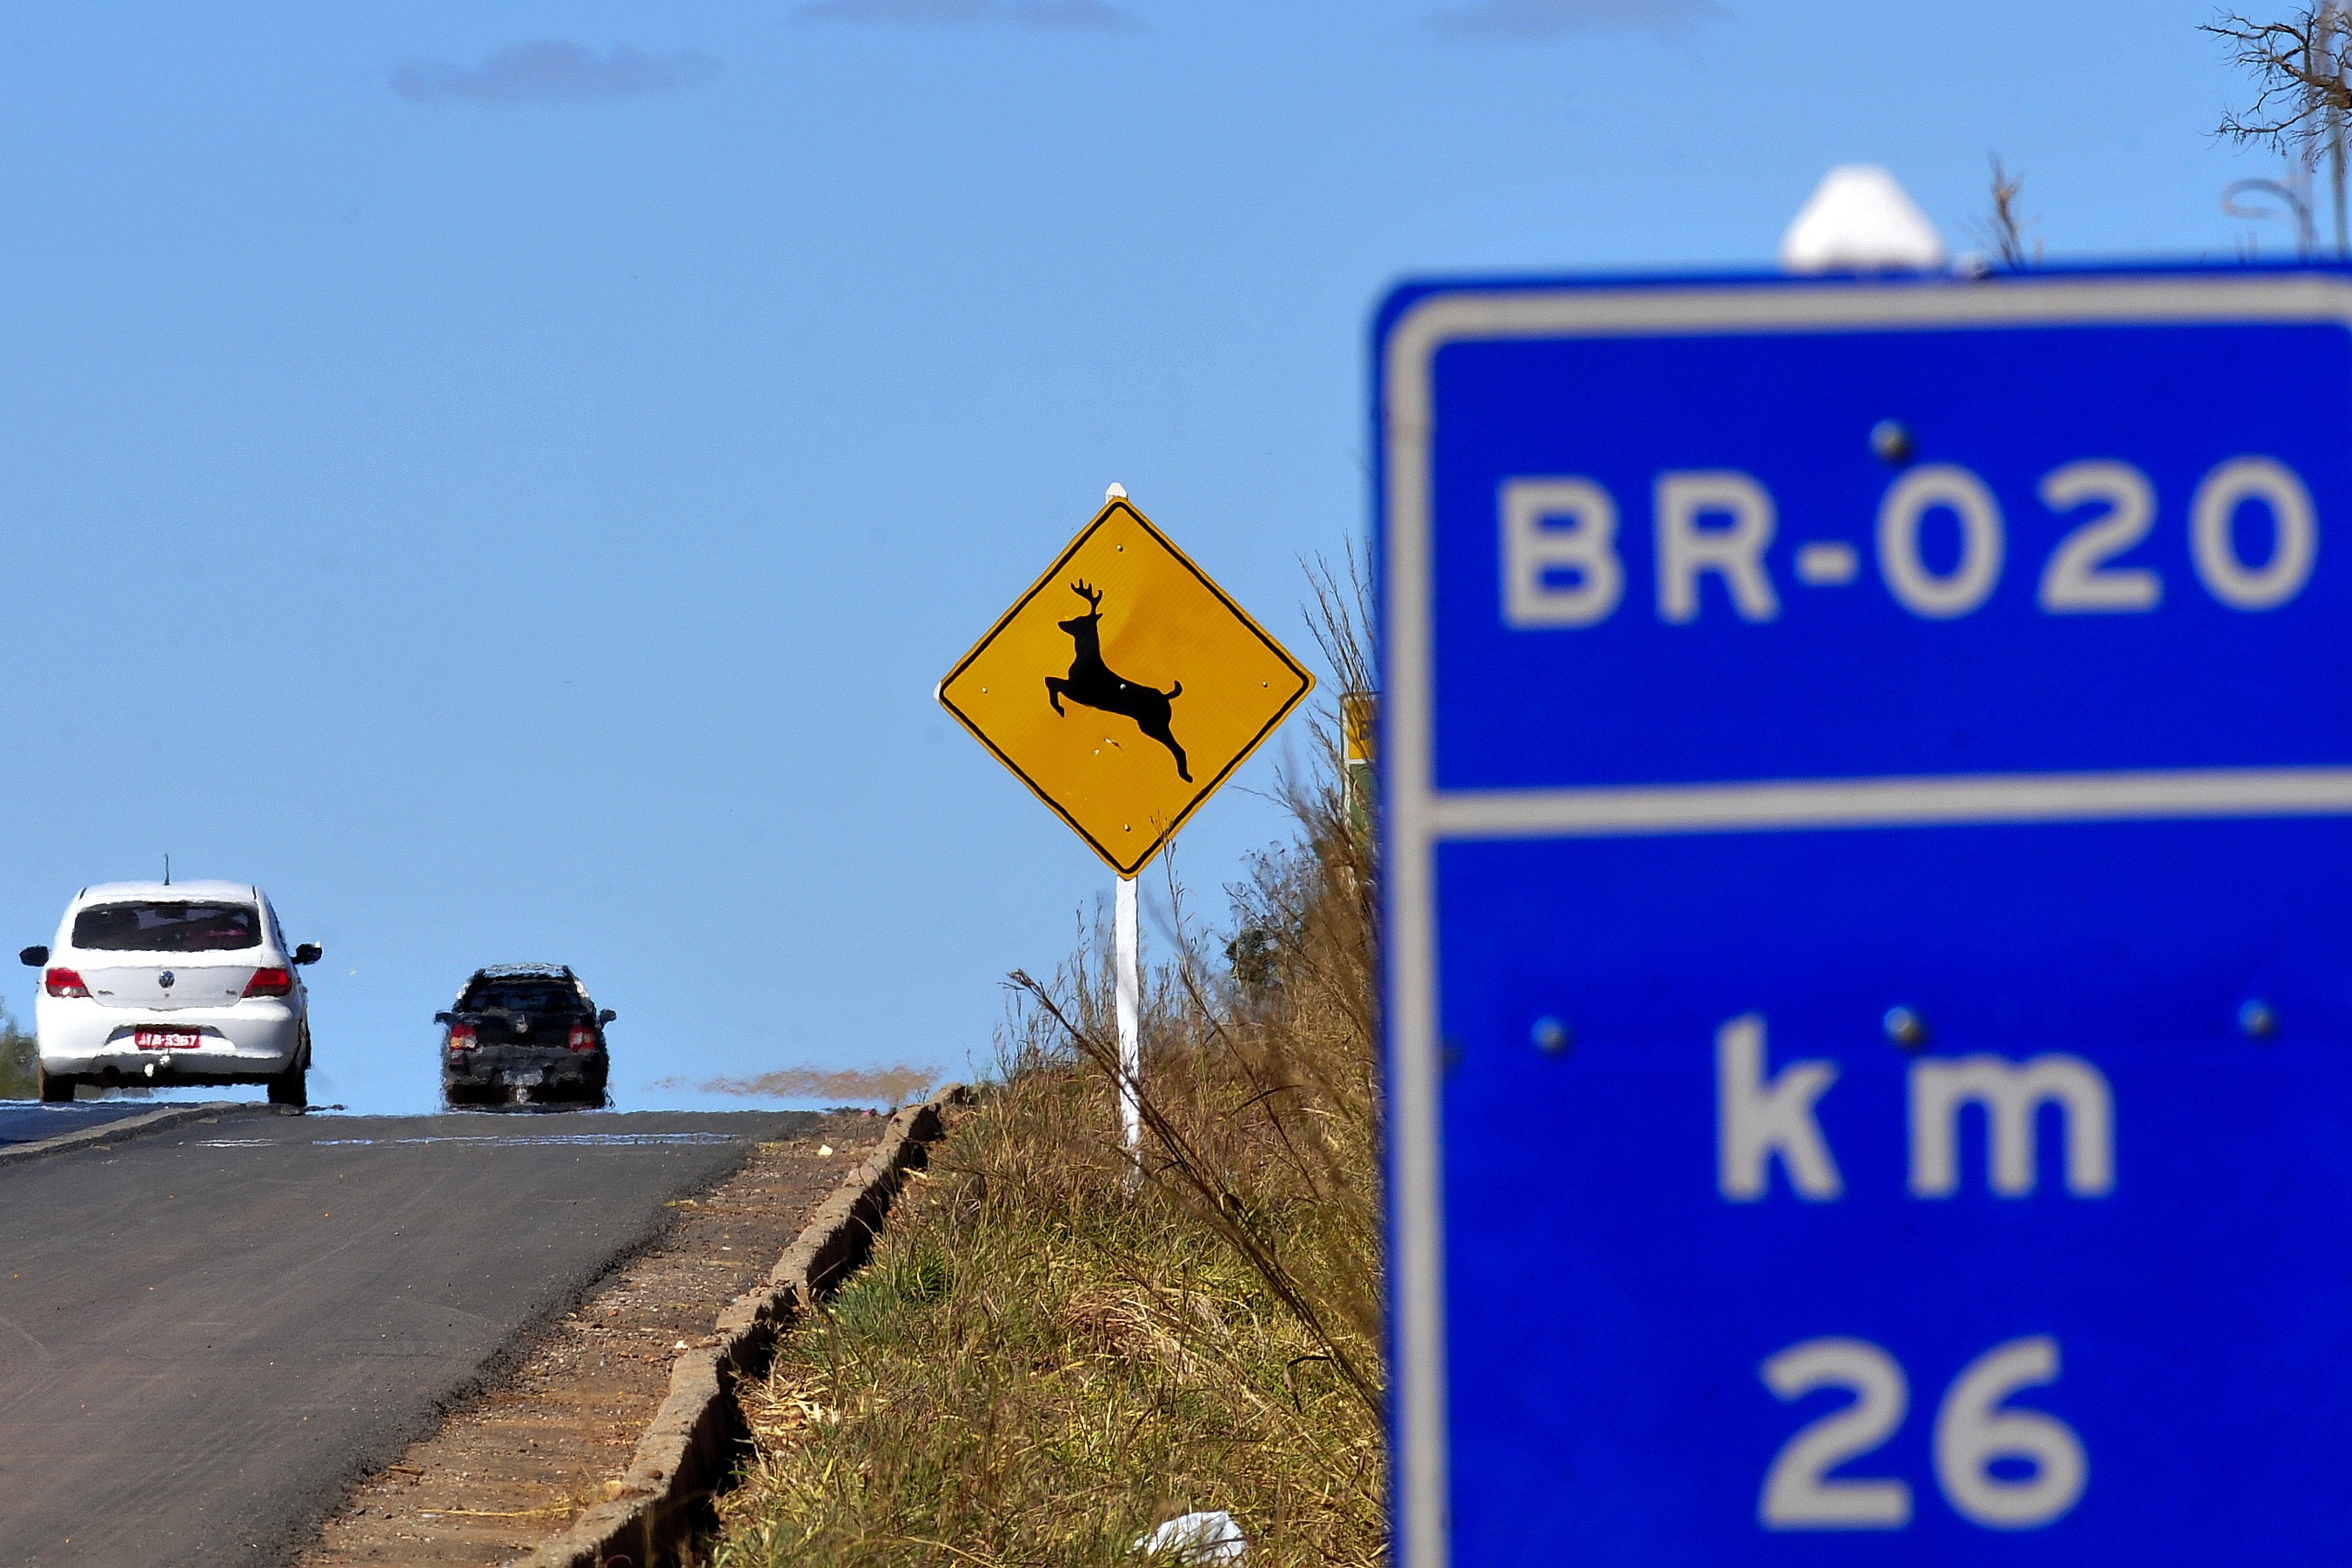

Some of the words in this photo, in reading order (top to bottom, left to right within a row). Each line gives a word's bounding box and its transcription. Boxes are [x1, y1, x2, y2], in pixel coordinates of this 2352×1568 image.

[1501, 459, 2315, 627] BR-020
[1718, 1017, 2113, 1198] km
[1761, 1339, 2086, 1527] 26
